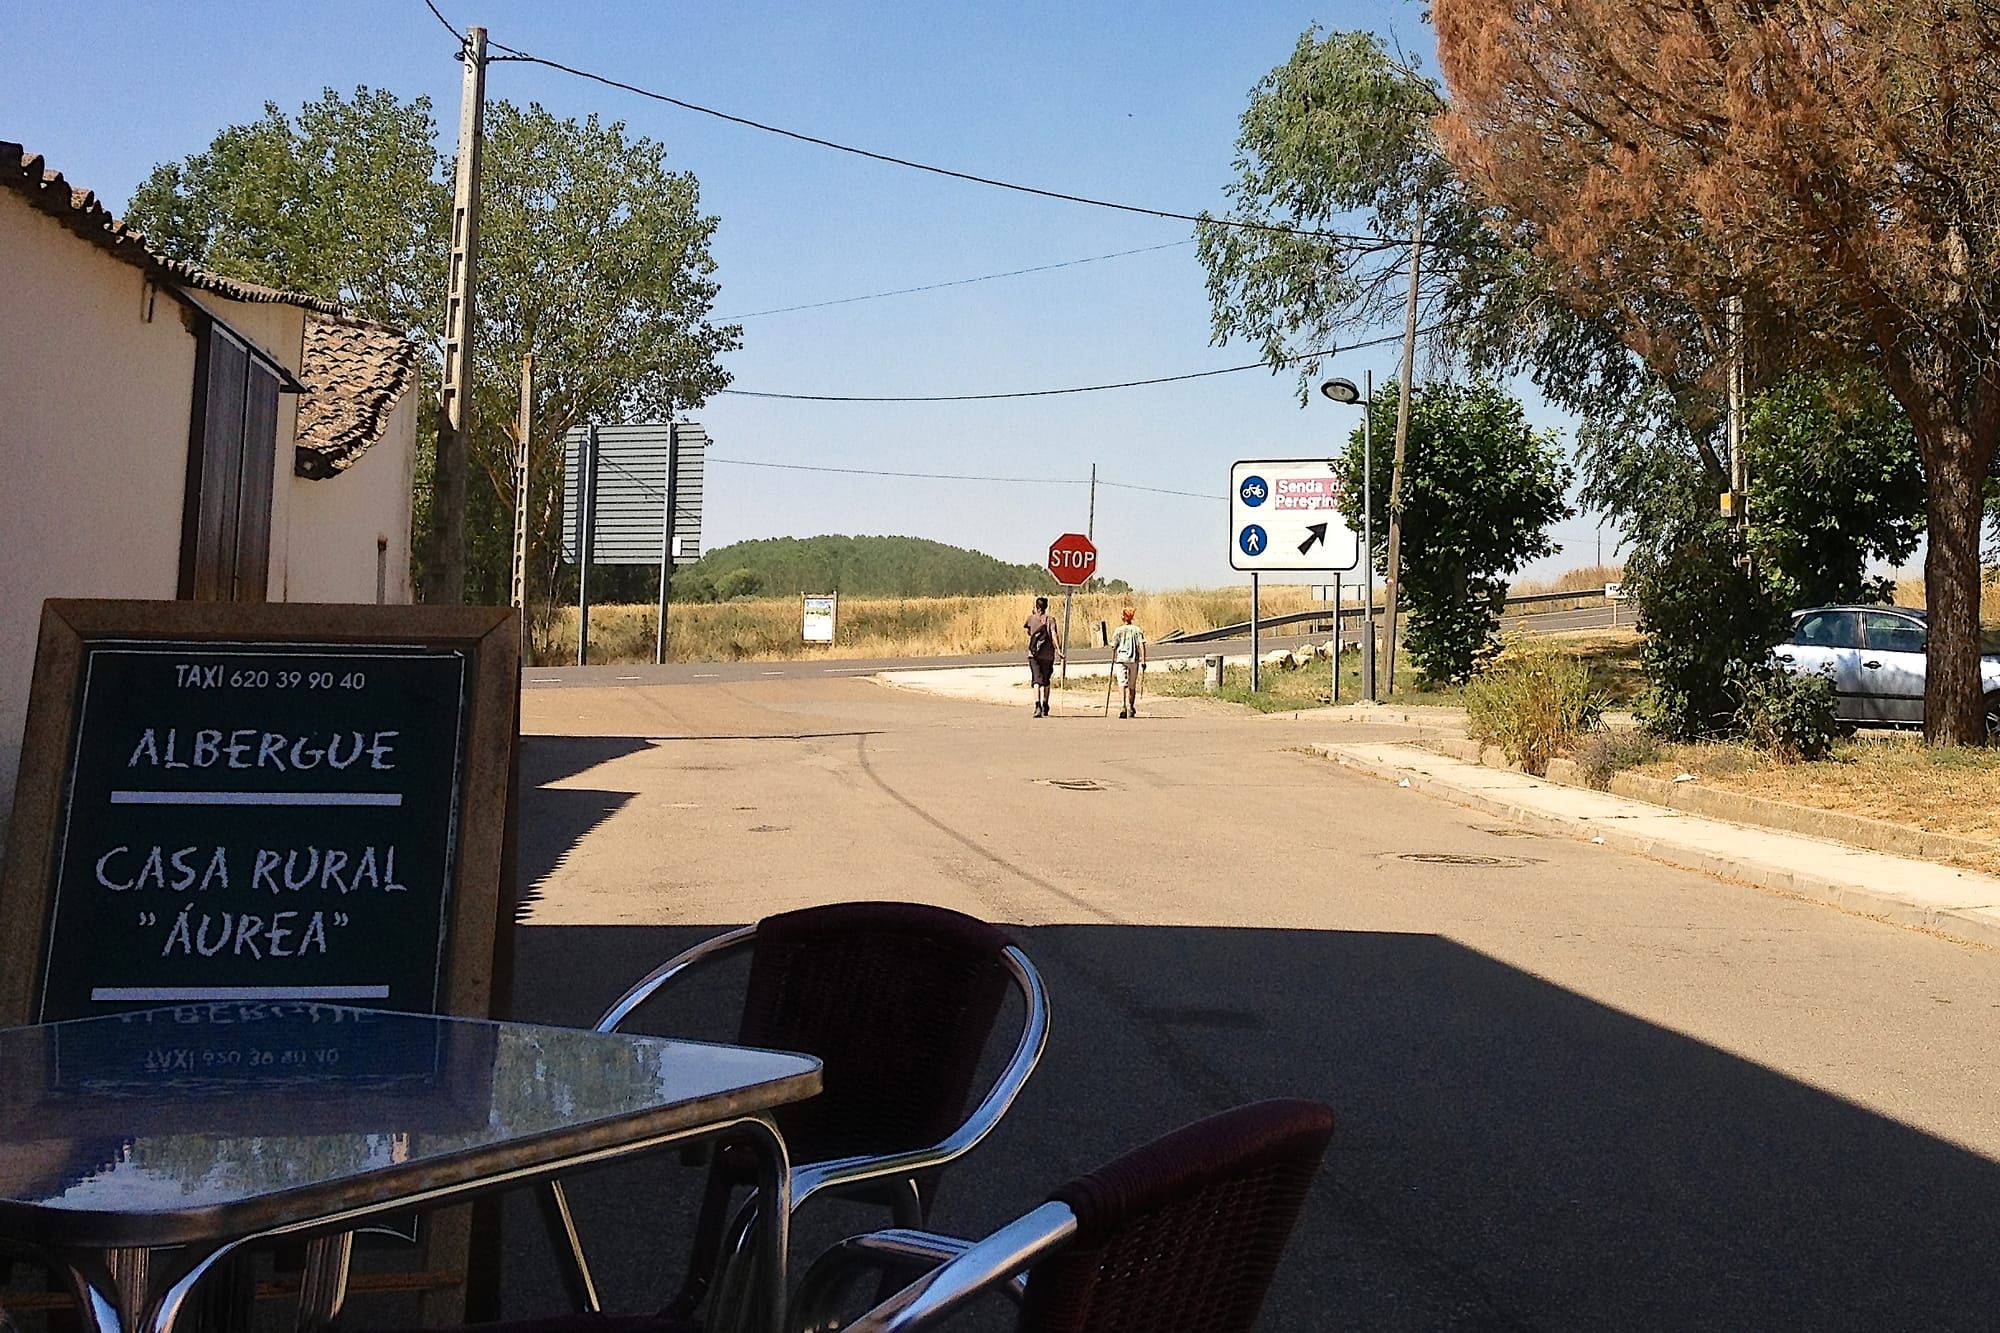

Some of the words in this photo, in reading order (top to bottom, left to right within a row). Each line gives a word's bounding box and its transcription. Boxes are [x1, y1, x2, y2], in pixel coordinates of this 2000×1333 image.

[1278, 480, 1323, 493] Senda
[1050, 549, 1095, 569] STOP
[175, 664, 224, 689] TAXI
[230, 670, 269, 689] 620
[275, 670, 302, 690] 39
[308, 671, 334, 690] 90
[340, 671, 366, 690] 40
[127, 727, 400, 772] ALBERGUE
[95, 845, 230, 893] CASA
[251, 845, 408, 896] RURAL
